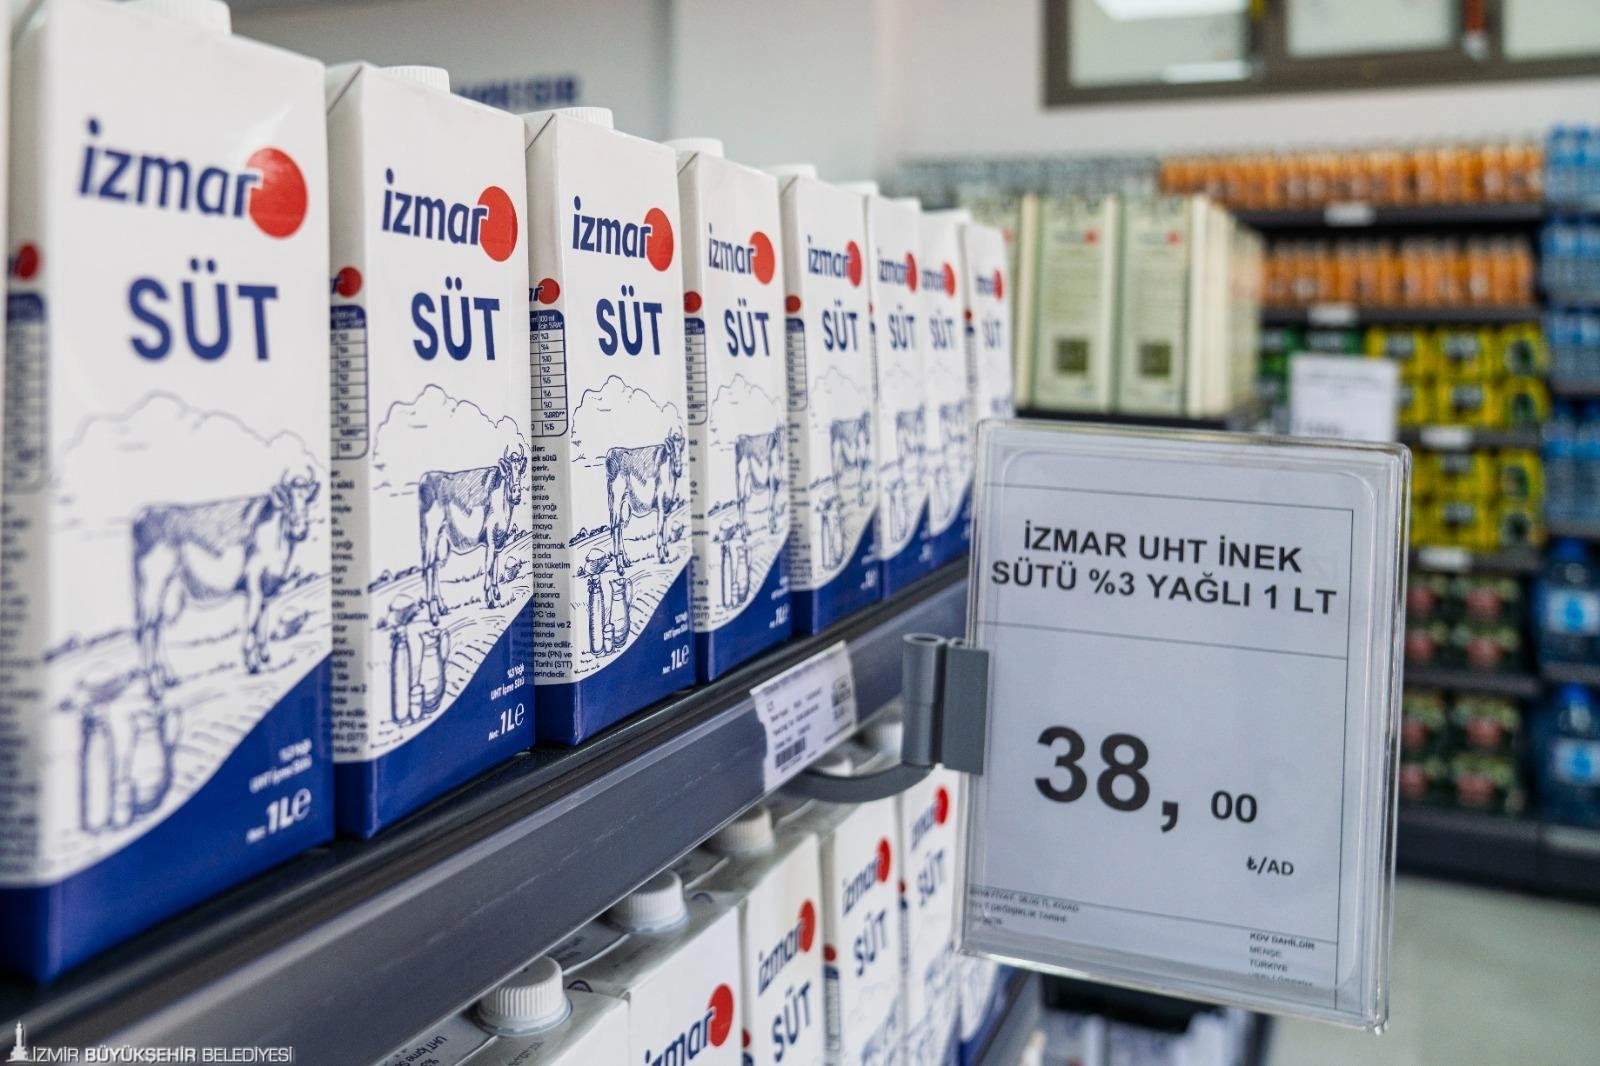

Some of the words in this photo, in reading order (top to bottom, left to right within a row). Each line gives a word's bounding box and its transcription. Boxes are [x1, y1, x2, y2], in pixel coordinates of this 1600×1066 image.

[80, 118, 260, 218] izmar
[382, 168, 487, 245] izmar
[572, 196, 651, 259] izmar
[708, 222, 755, 275] izmar
[128, 258, 278, 361] SÜT
[411, 276, 500, 361] SÜT
[596, 284, 663, 356] SÜT
[724, 298, 770, 358] SÜT
[822, 300, 858, 351] SÜT
[888, 305, 915, 350] SÜT
[1024, 520, 1127, 558] İZMAR
[1139, 534, 1208, 564] UHT
[1219, 535, 1302, 573] İNEK
[991, 556, 1077, 591] SÜTÜ
[1089, 568, 1136, 597] %3
[1147, 571, 1251, 607] YAĞLI
[1263, 584, 1278, 610] 1
[1294, 587, 1337, 615] LT
[1211, 790, 1258, 823] 00
[854, 908, 887, 976] SÜT
[772, 981, 812, 1063] SÜT
